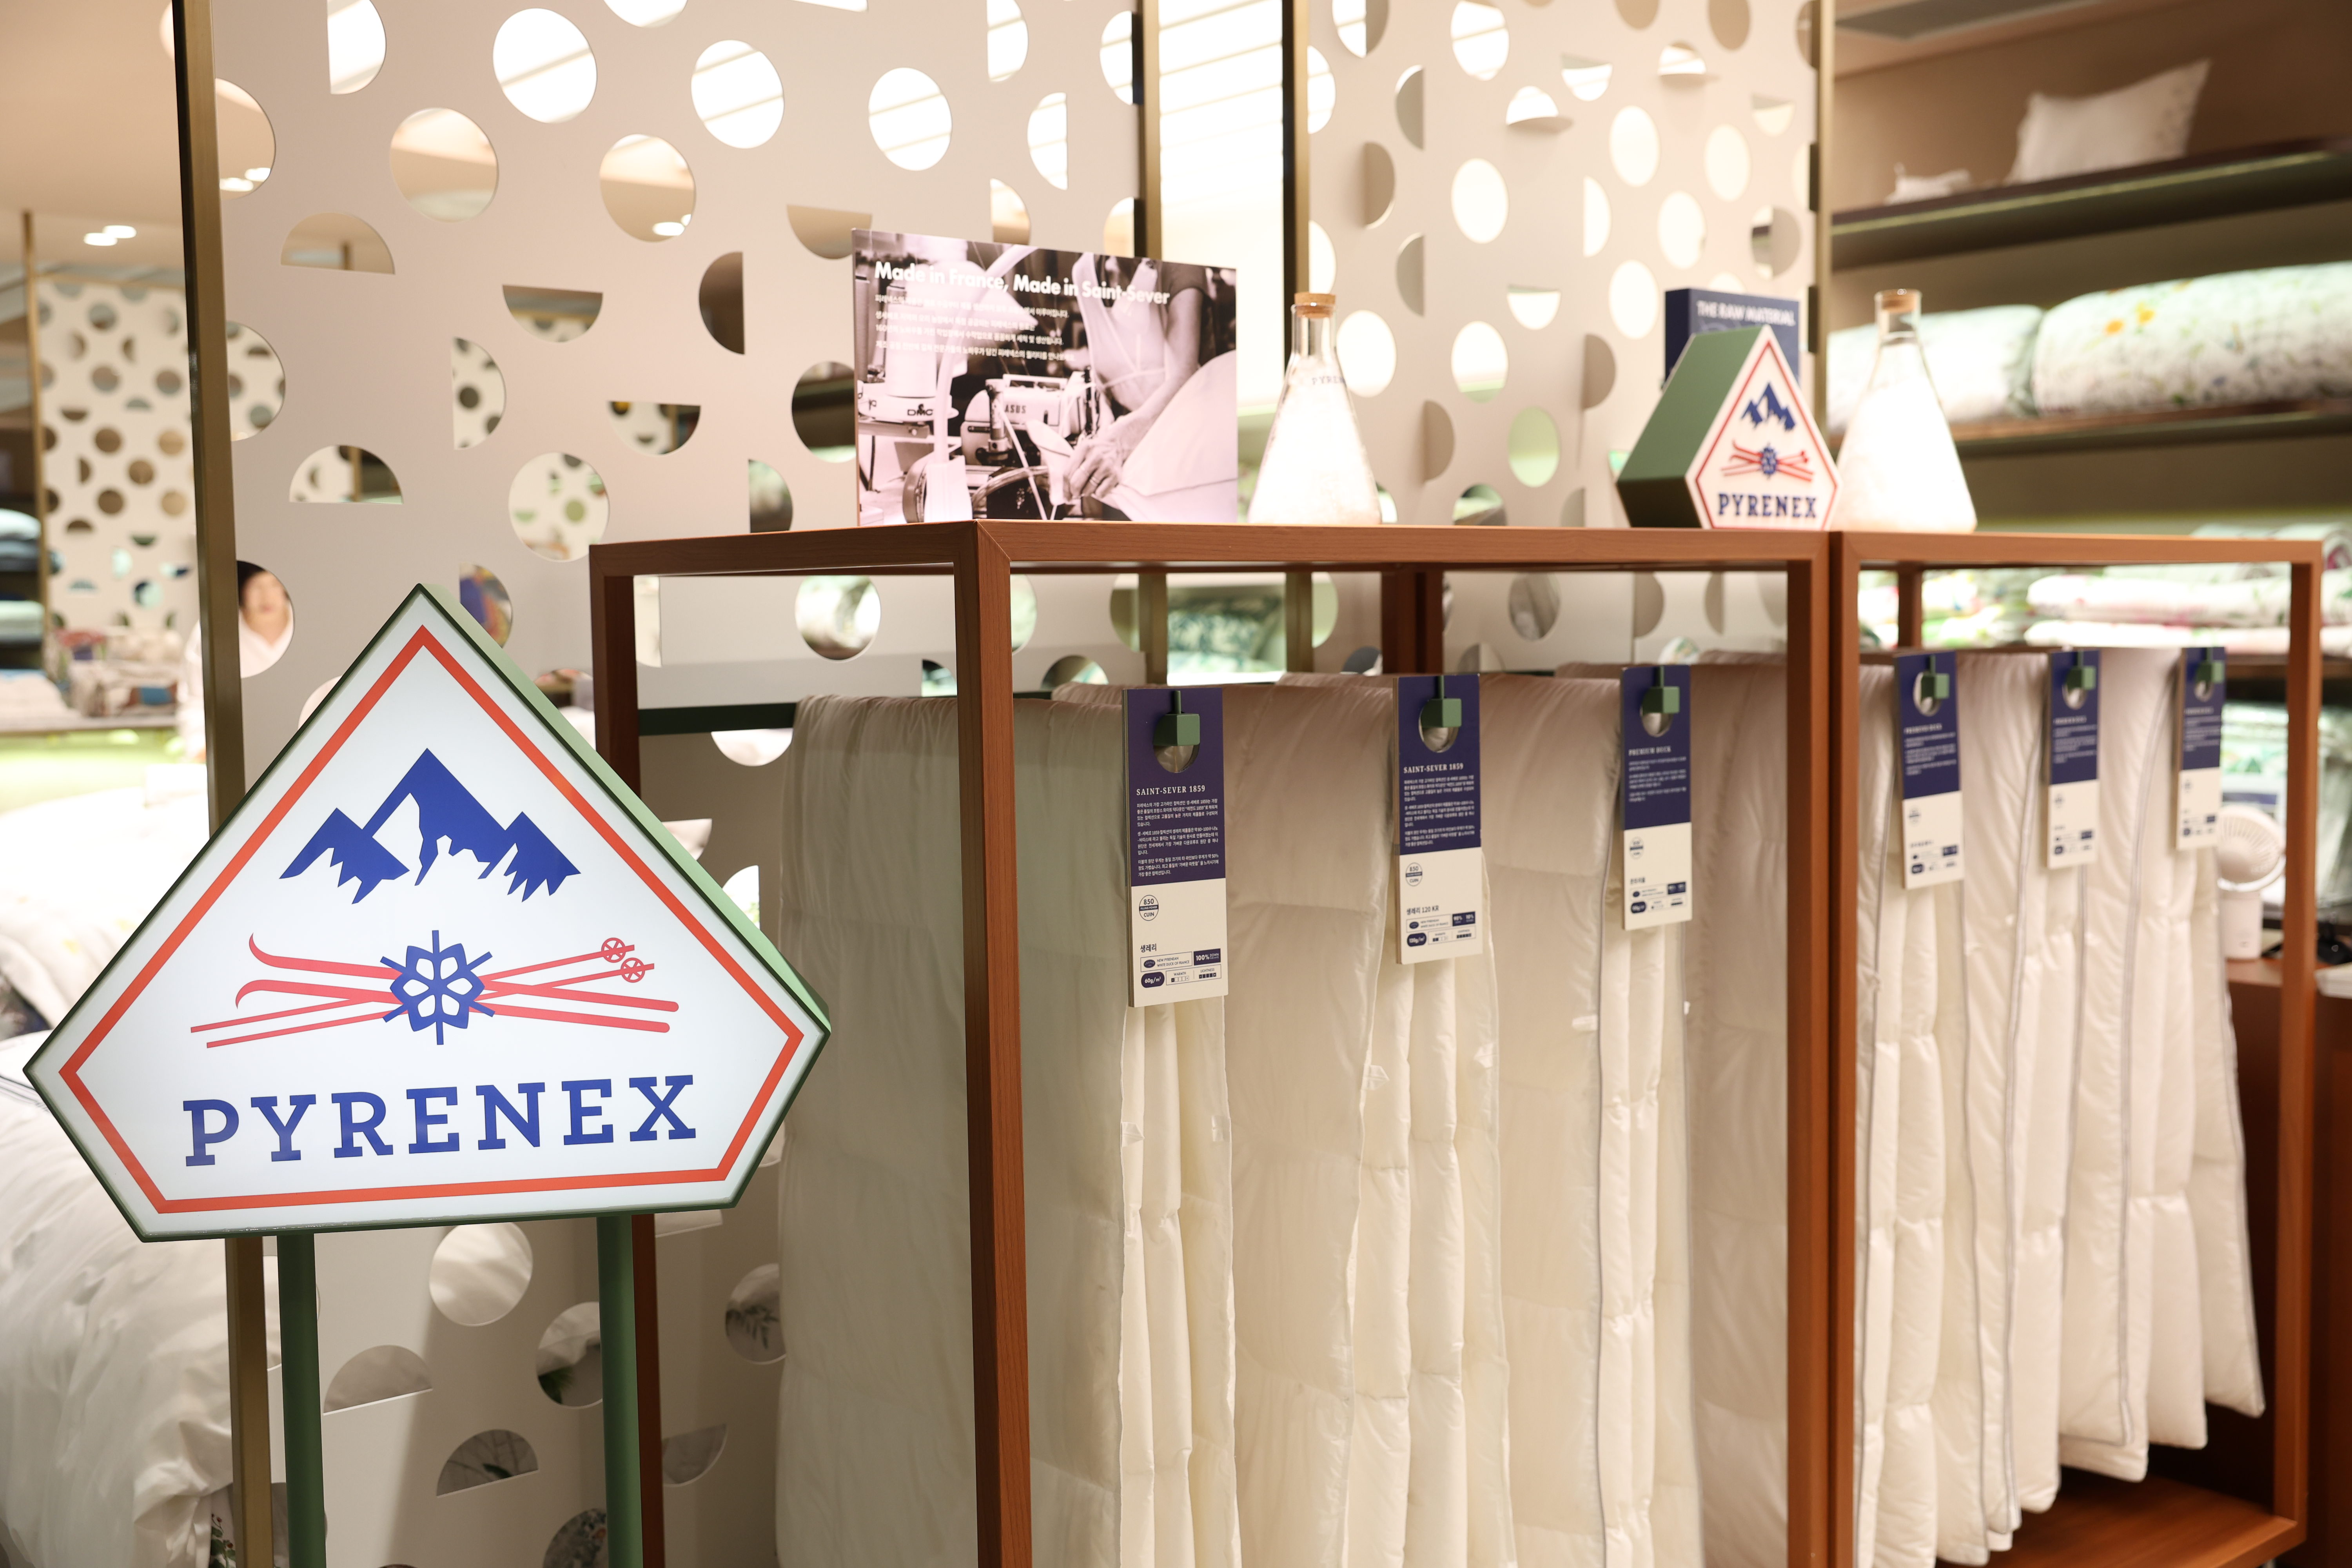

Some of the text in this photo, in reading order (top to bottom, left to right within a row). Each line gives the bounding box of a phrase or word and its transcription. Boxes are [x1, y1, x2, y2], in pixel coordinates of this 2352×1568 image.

[875, 261, 1170, 304] Made in France, Made in Saint-Sever
[1696, 300, 1796, 327] THE RAW MATERIAL
[1718, 493, 1817, 518] PYRENEX
[1403, 762, 1464, 774] SAINT-SEVER 1859
[1136, 786, 1187, 795] SAINT-SEVER
[1140, 944, 1157, 953] 생레리
[184, 1075, 695, 1165] PYRENEX
